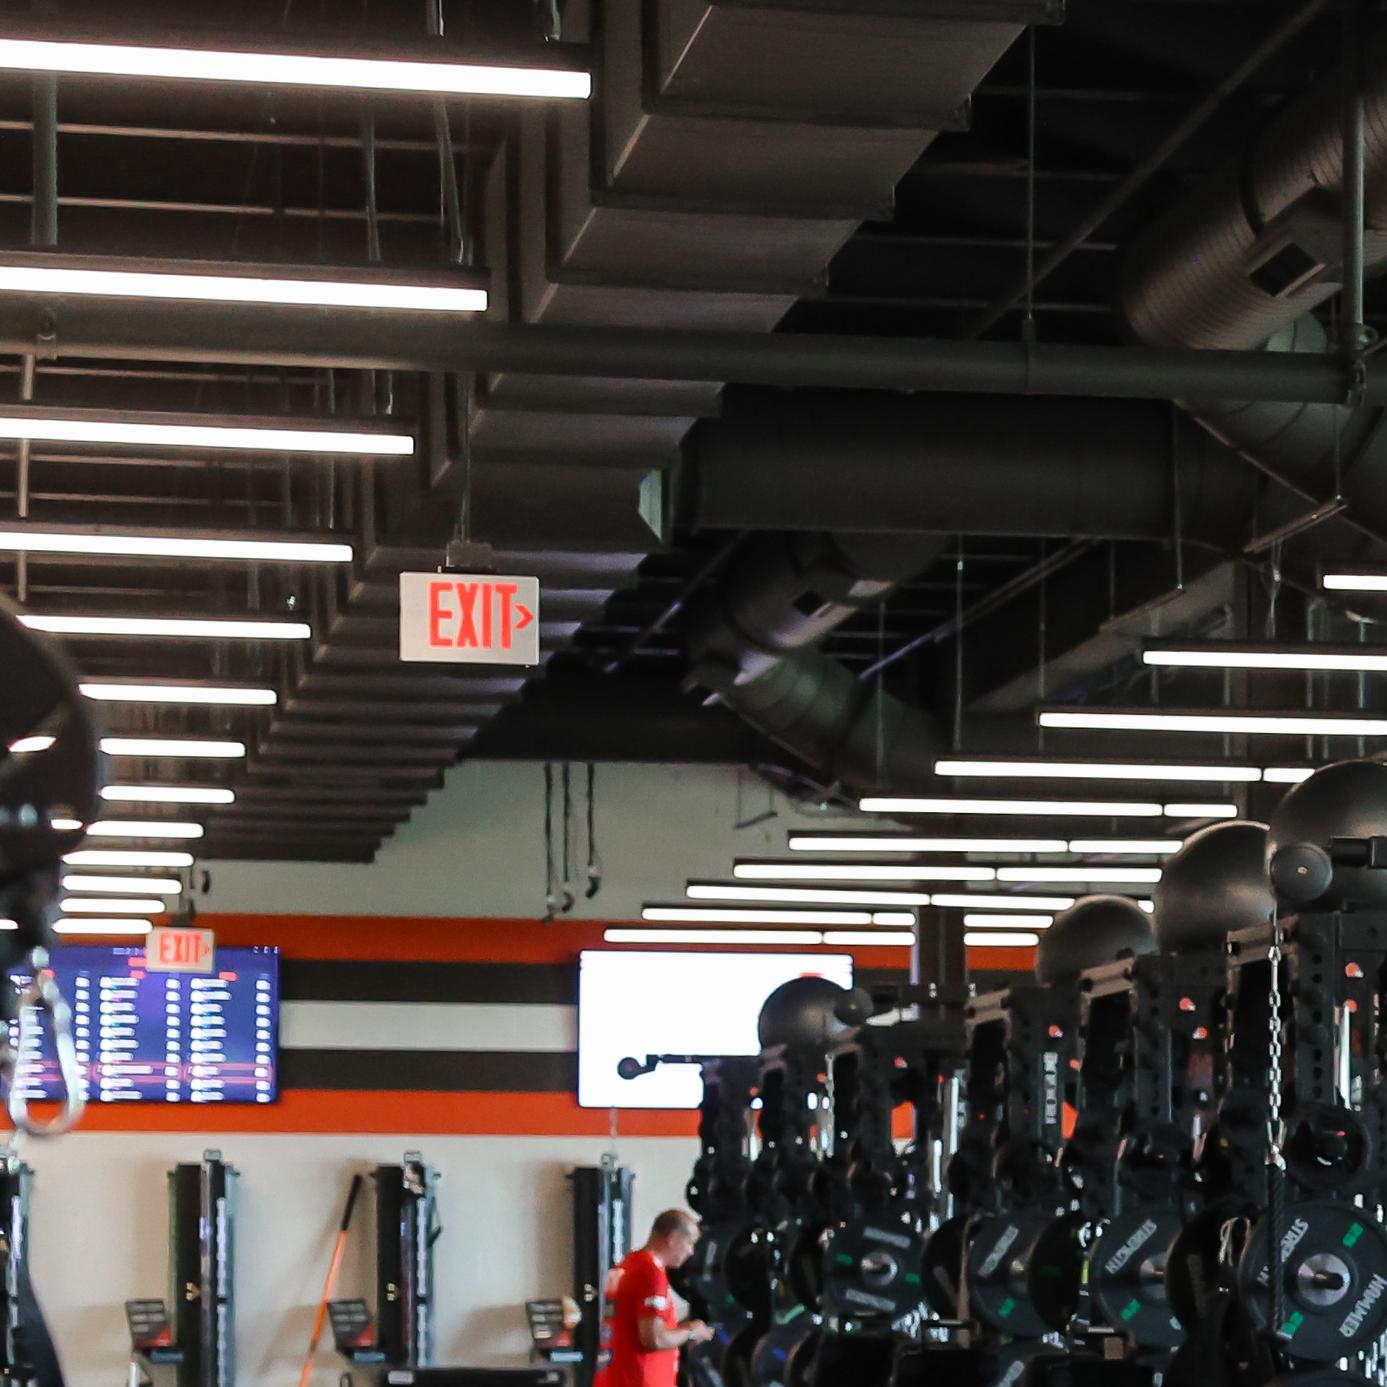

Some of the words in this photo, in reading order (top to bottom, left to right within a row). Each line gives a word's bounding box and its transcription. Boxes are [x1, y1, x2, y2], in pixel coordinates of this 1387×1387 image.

[429, 581, 518, 649] EXIT
[160, 932, 202, 964] EXIT
[1338, 1273, 1387, 1339] HAMMER
